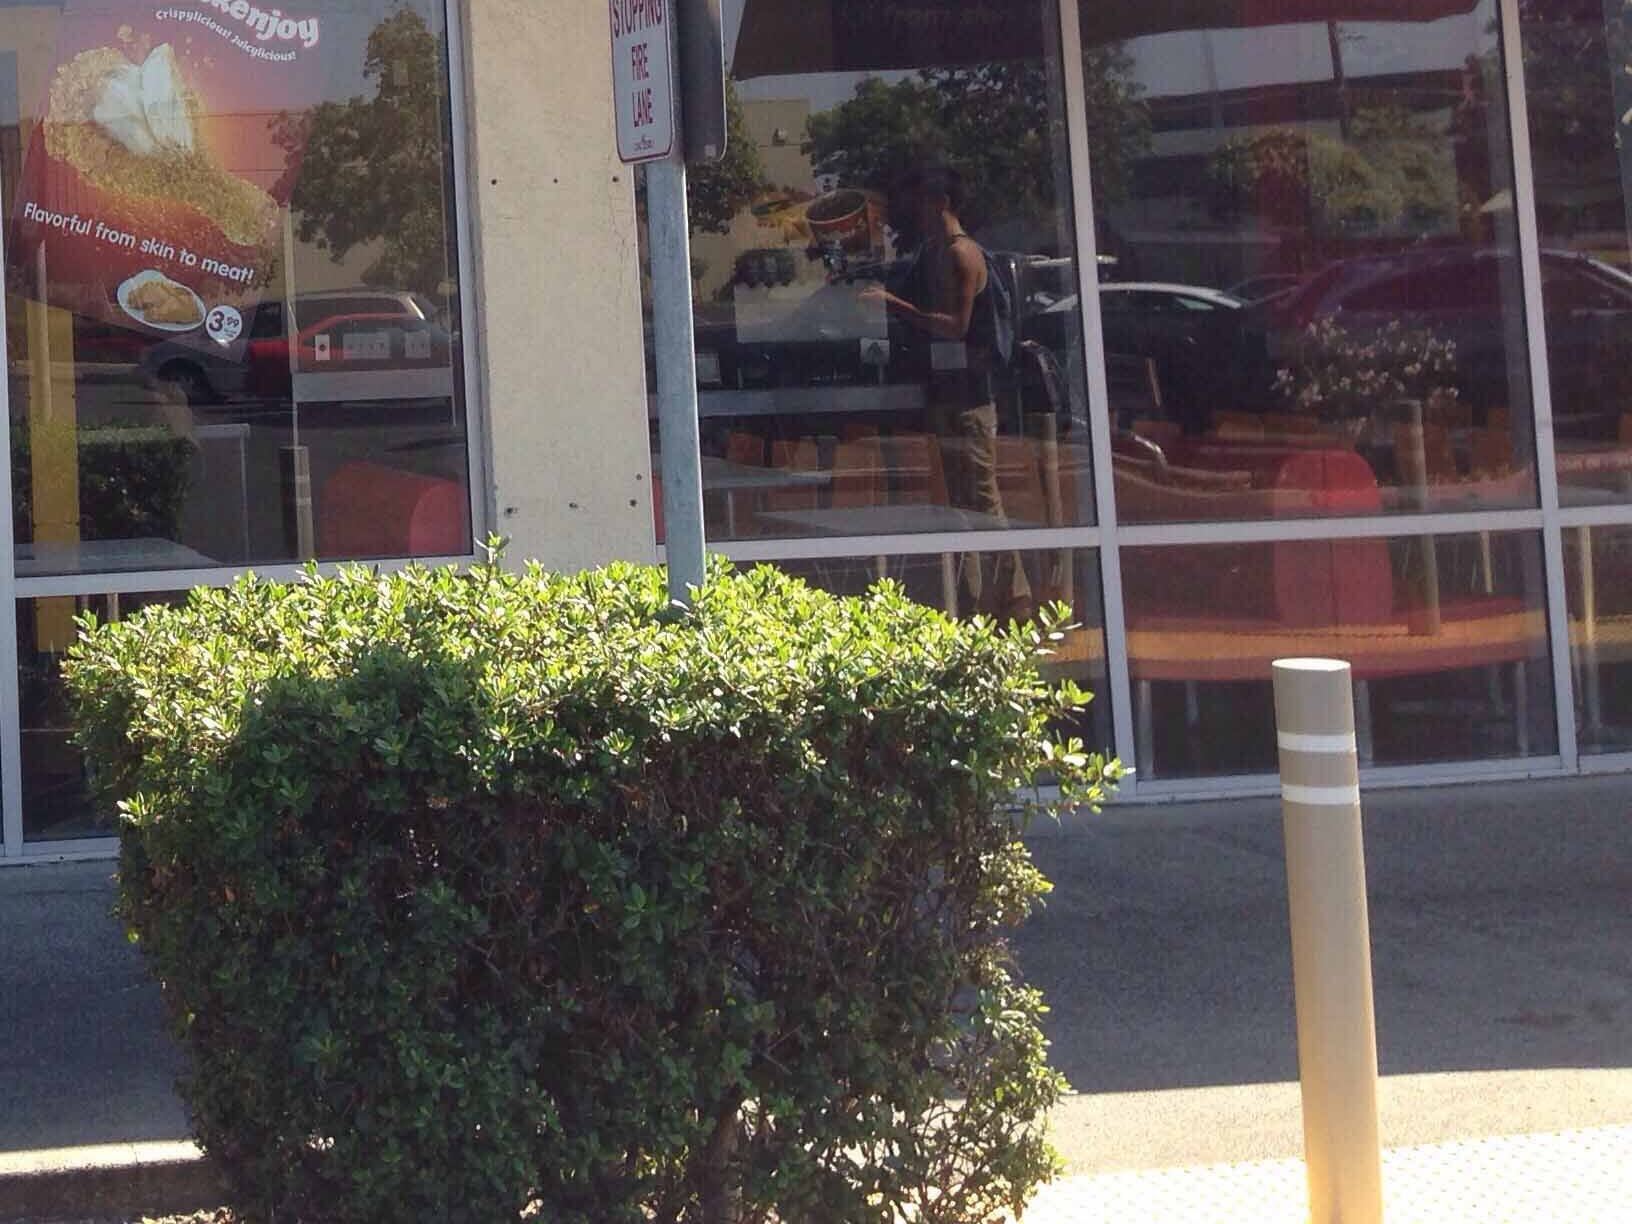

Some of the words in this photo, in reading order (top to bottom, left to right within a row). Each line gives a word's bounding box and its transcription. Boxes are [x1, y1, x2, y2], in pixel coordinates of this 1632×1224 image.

[155, 8, 231, 40] Crispylicious!
[231, 34, 296, 62] Juicylicious!
[631, 43, 650, 81] FIRE
[631, 88, 654, 127] LANE
[23, 202, 93, 236] Flavorful
[95, 222, 137, 249] from
[139, 236, 175, 261] skin
[179, 248, 197, 266] to
[201, 257, 255, 285] meat!
